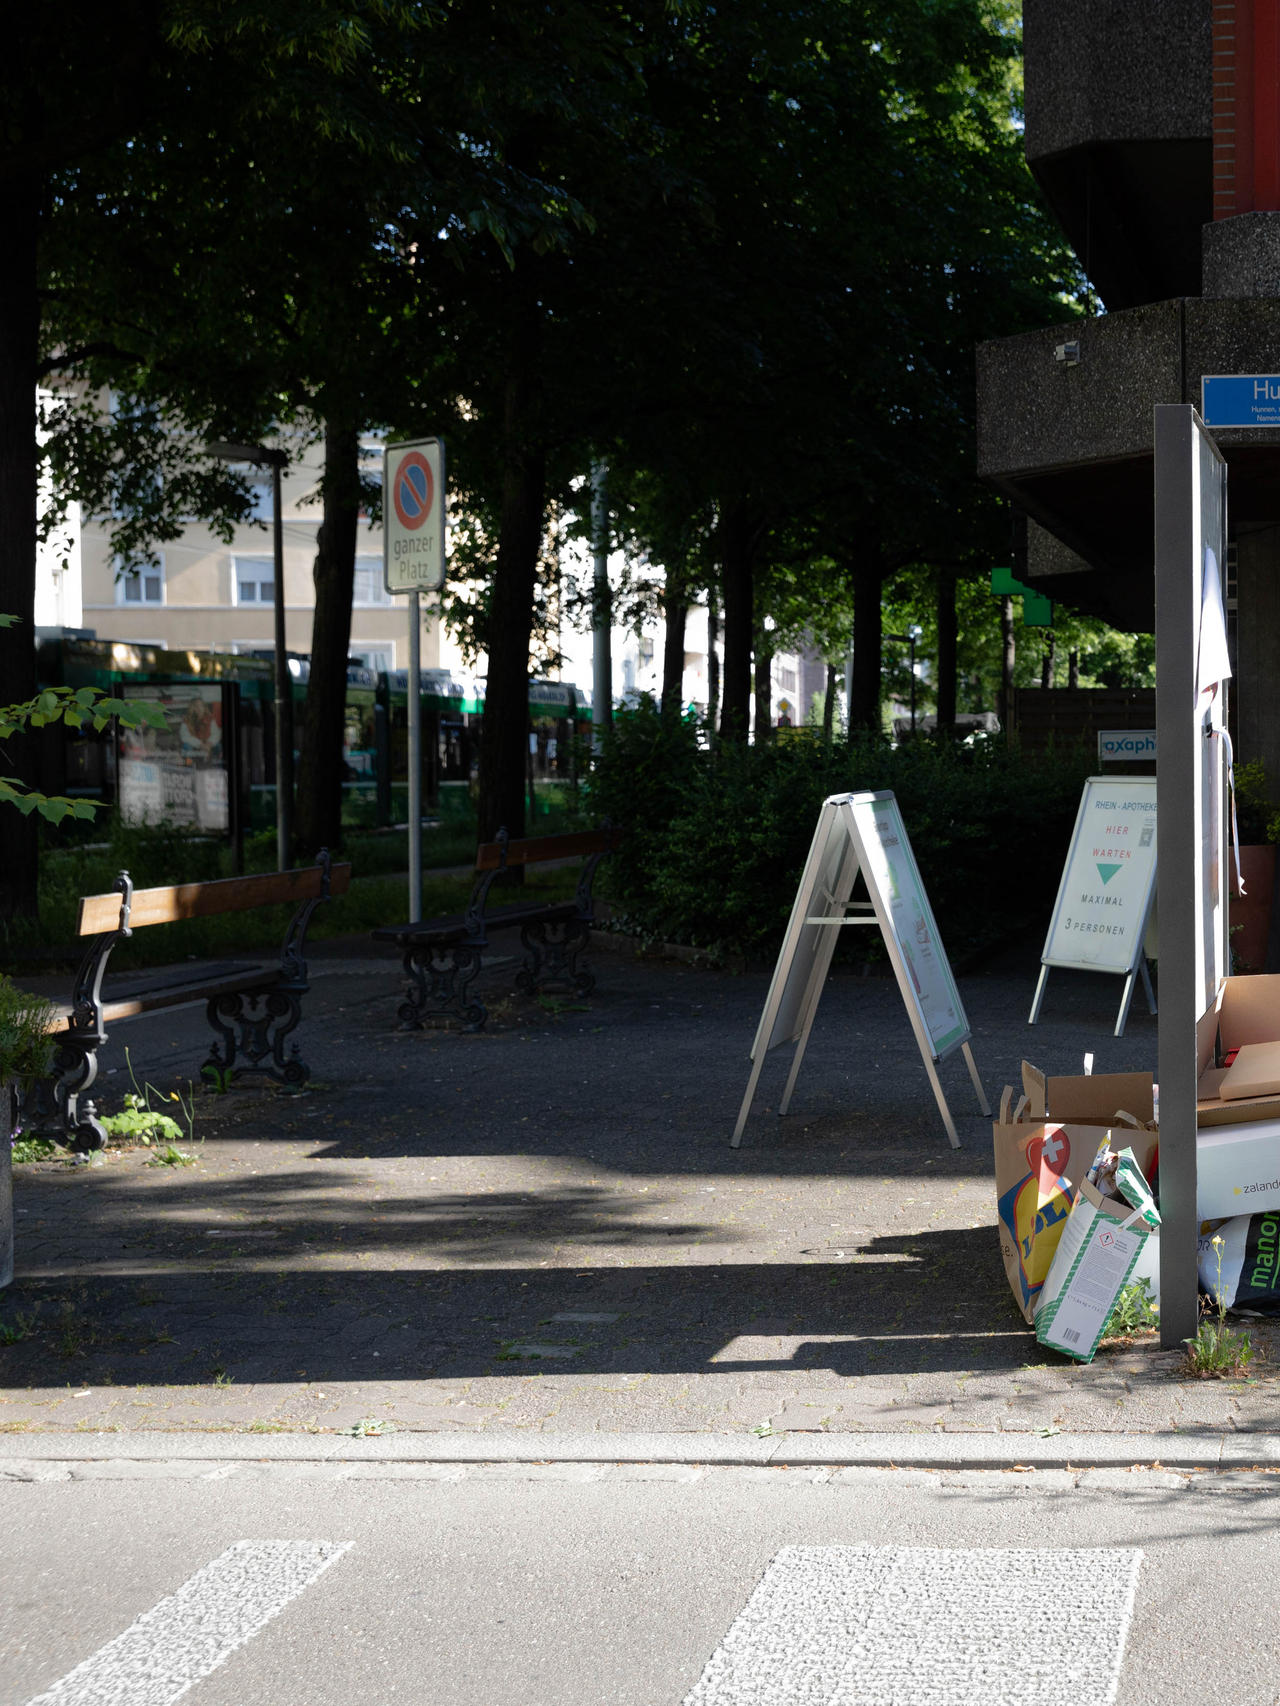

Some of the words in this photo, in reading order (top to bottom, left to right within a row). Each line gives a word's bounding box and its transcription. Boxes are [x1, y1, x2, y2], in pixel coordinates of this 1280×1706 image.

[393, 535, 434, 560] ganzer
[399, 557, 430, 580] Platz
[1095, 800, 1117, 811] RHEIN
[1105, 825, 1129, 835] HIER
[1092, 848, 1132, 858] WARTEN
[1081, 894, 1123, 906] MAXIMAL
[1064, 918, 1072, 930] 3
[1073, 922, 1125, 935] PERSONEN
